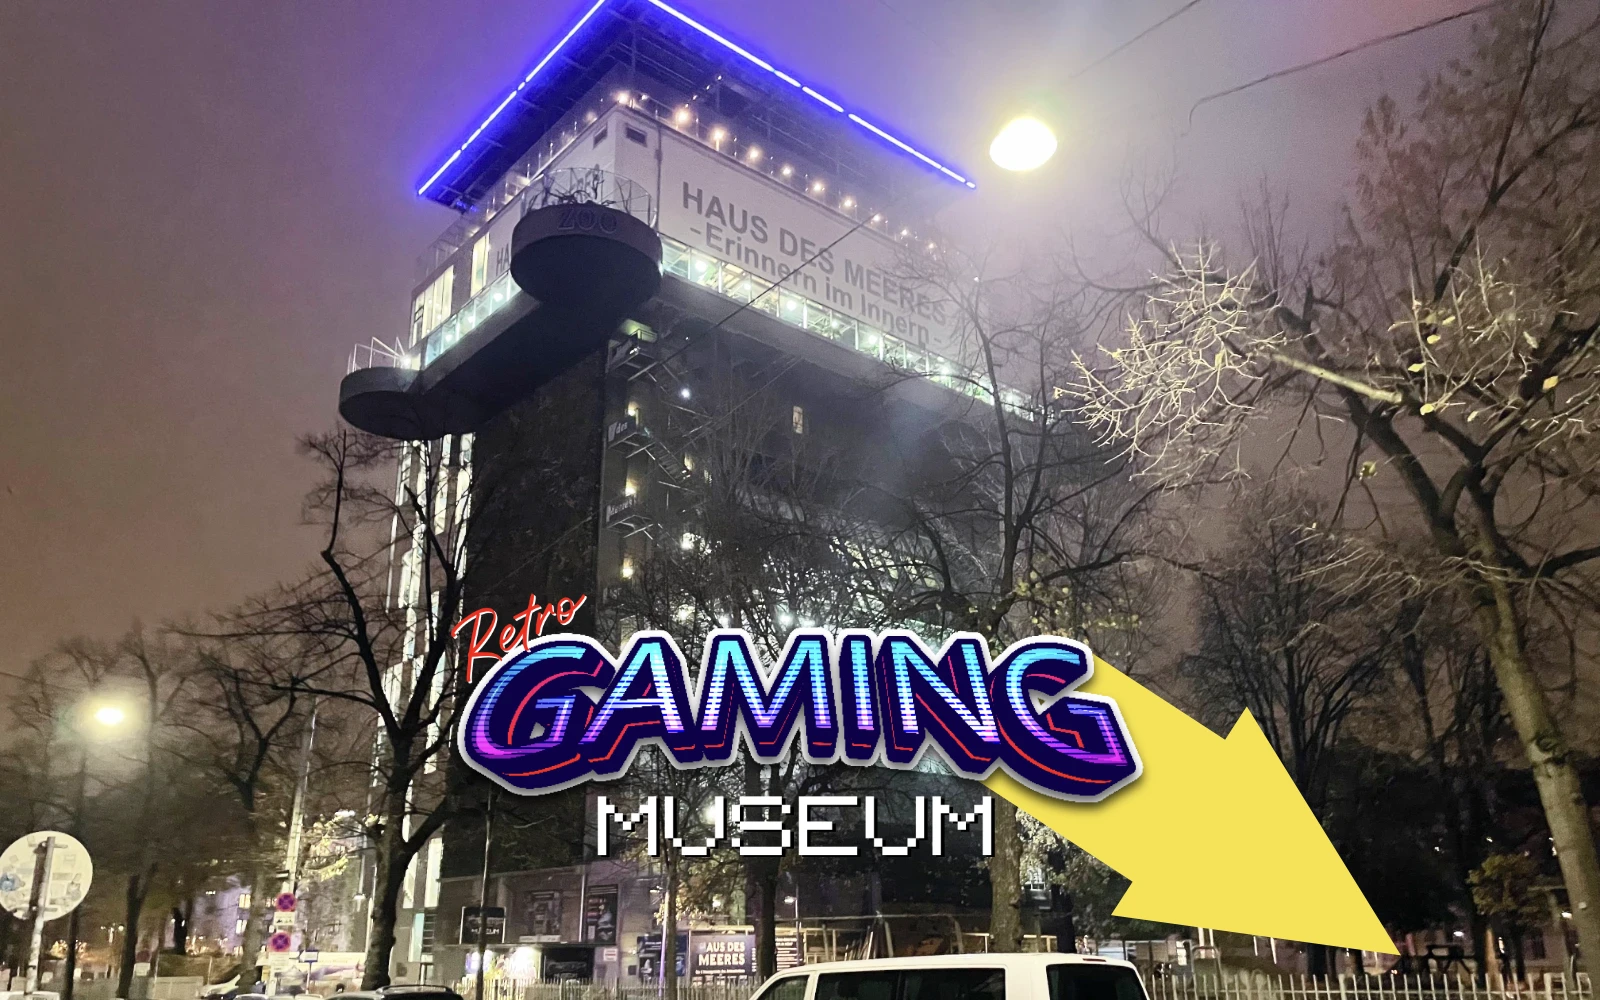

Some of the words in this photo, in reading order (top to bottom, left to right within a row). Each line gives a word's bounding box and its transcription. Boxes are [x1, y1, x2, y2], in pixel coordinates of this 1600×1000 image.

[558, 205, 618, 234] ZOO
[682, 181, 769, 244] HAUS
[779, 226, 835, 276] DES
[844, 258, 947, 327] MEERES
[825, 275, 853, 311] im
[698, 953, 746, 966] MEERES
[727, 941, 746, 953] DES
